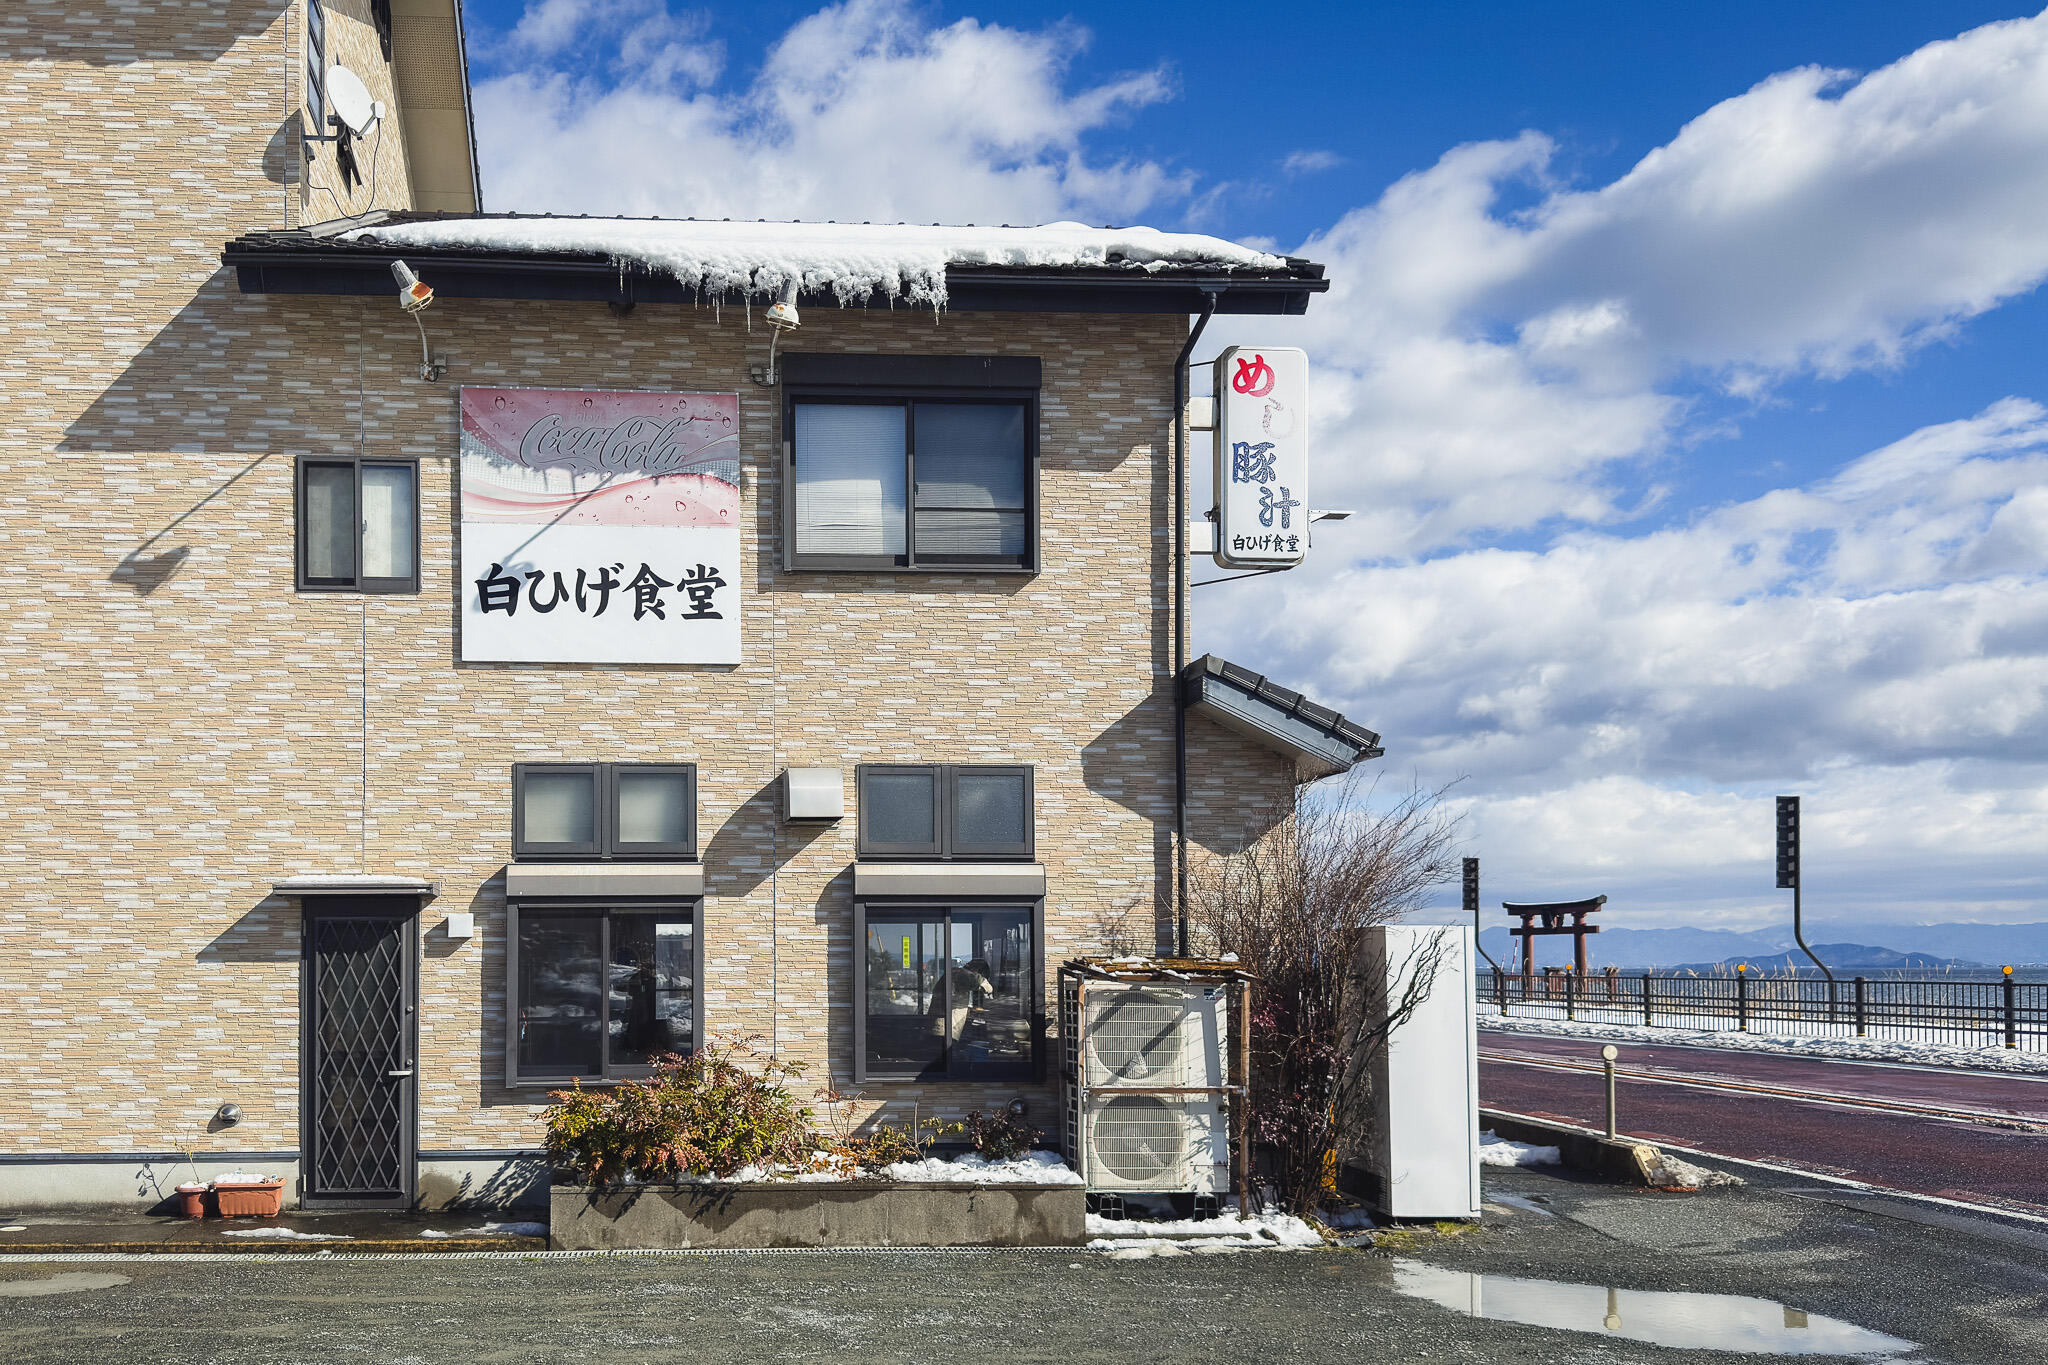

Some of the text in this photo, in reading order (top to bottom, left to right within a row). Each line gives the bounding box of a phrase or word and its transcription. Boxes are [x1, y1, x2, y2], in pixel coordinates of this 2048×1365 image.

[520, 413, 694, 472] Coca-Cola
[1232, 441, 1300, 529] 豚汁
[1233, 534, 1300, 552] 白ひげ食堂
[474, 562, 727, 621] 白ひげ食堂
